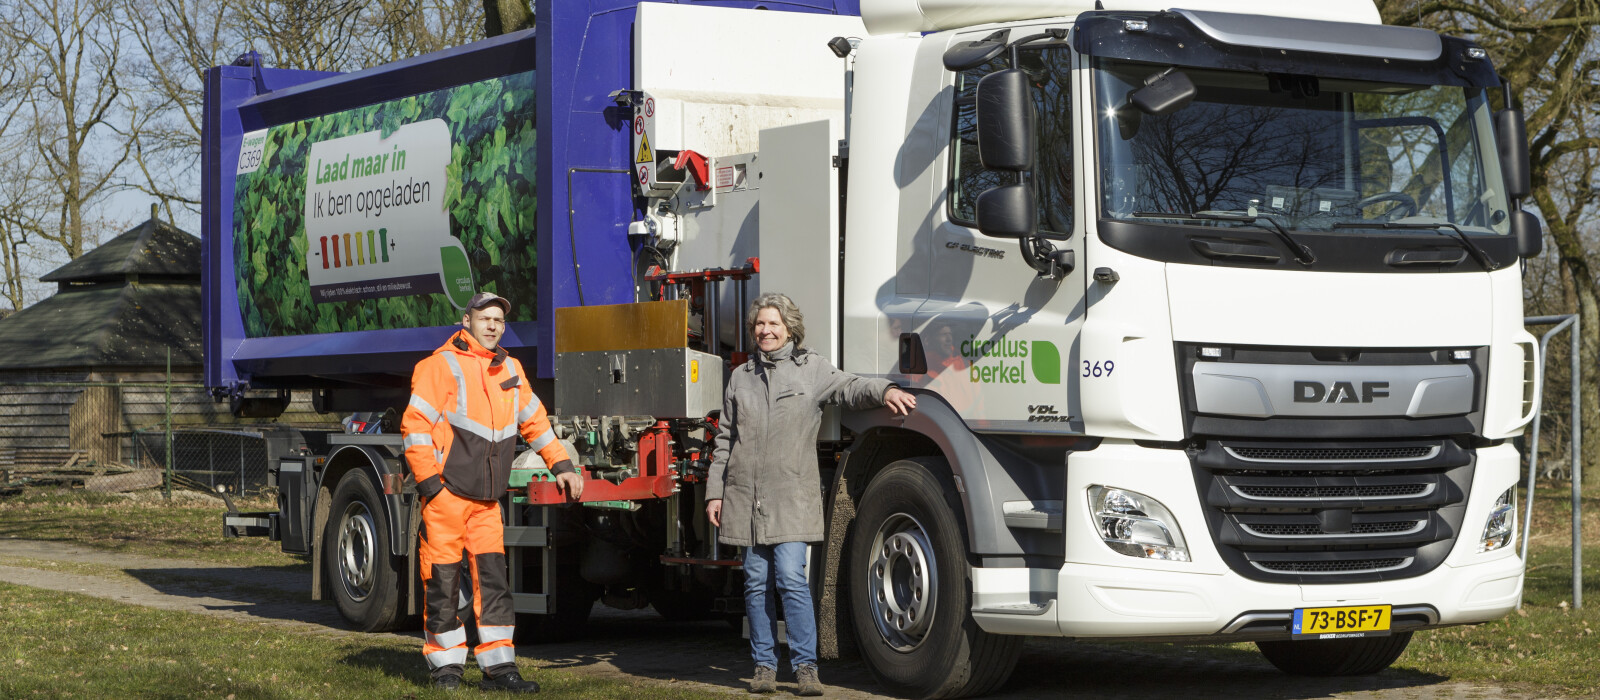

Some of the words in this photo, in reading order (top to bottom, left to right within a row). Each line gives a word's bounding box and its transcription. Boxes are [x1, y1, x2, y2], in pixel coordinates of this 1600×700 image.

[243, 136, 264, 148] E-wagen
[240, 149, 262, 169] C369
[316, 153, 350, 185] Laad
[351, 152, 389, 179] maar
[391, 144, 406, 172] in
[313, 191, 324, 218] Ik
[328, 189, 352, 216] ben
[356, 176, 430, 218] opgeladen
[960, 243, 1006, 260] ELECTRIC
[960, 334, 1029, 358] circulus
[970, 360, 1027, 384] berkel
[1082, 360, 1115, 377] 369
[1293, 380, 1390, 403] DAF
[1027, 404, 1059, 414] VDL
[1310, 609, 1383, 630] 73-BSF-7
